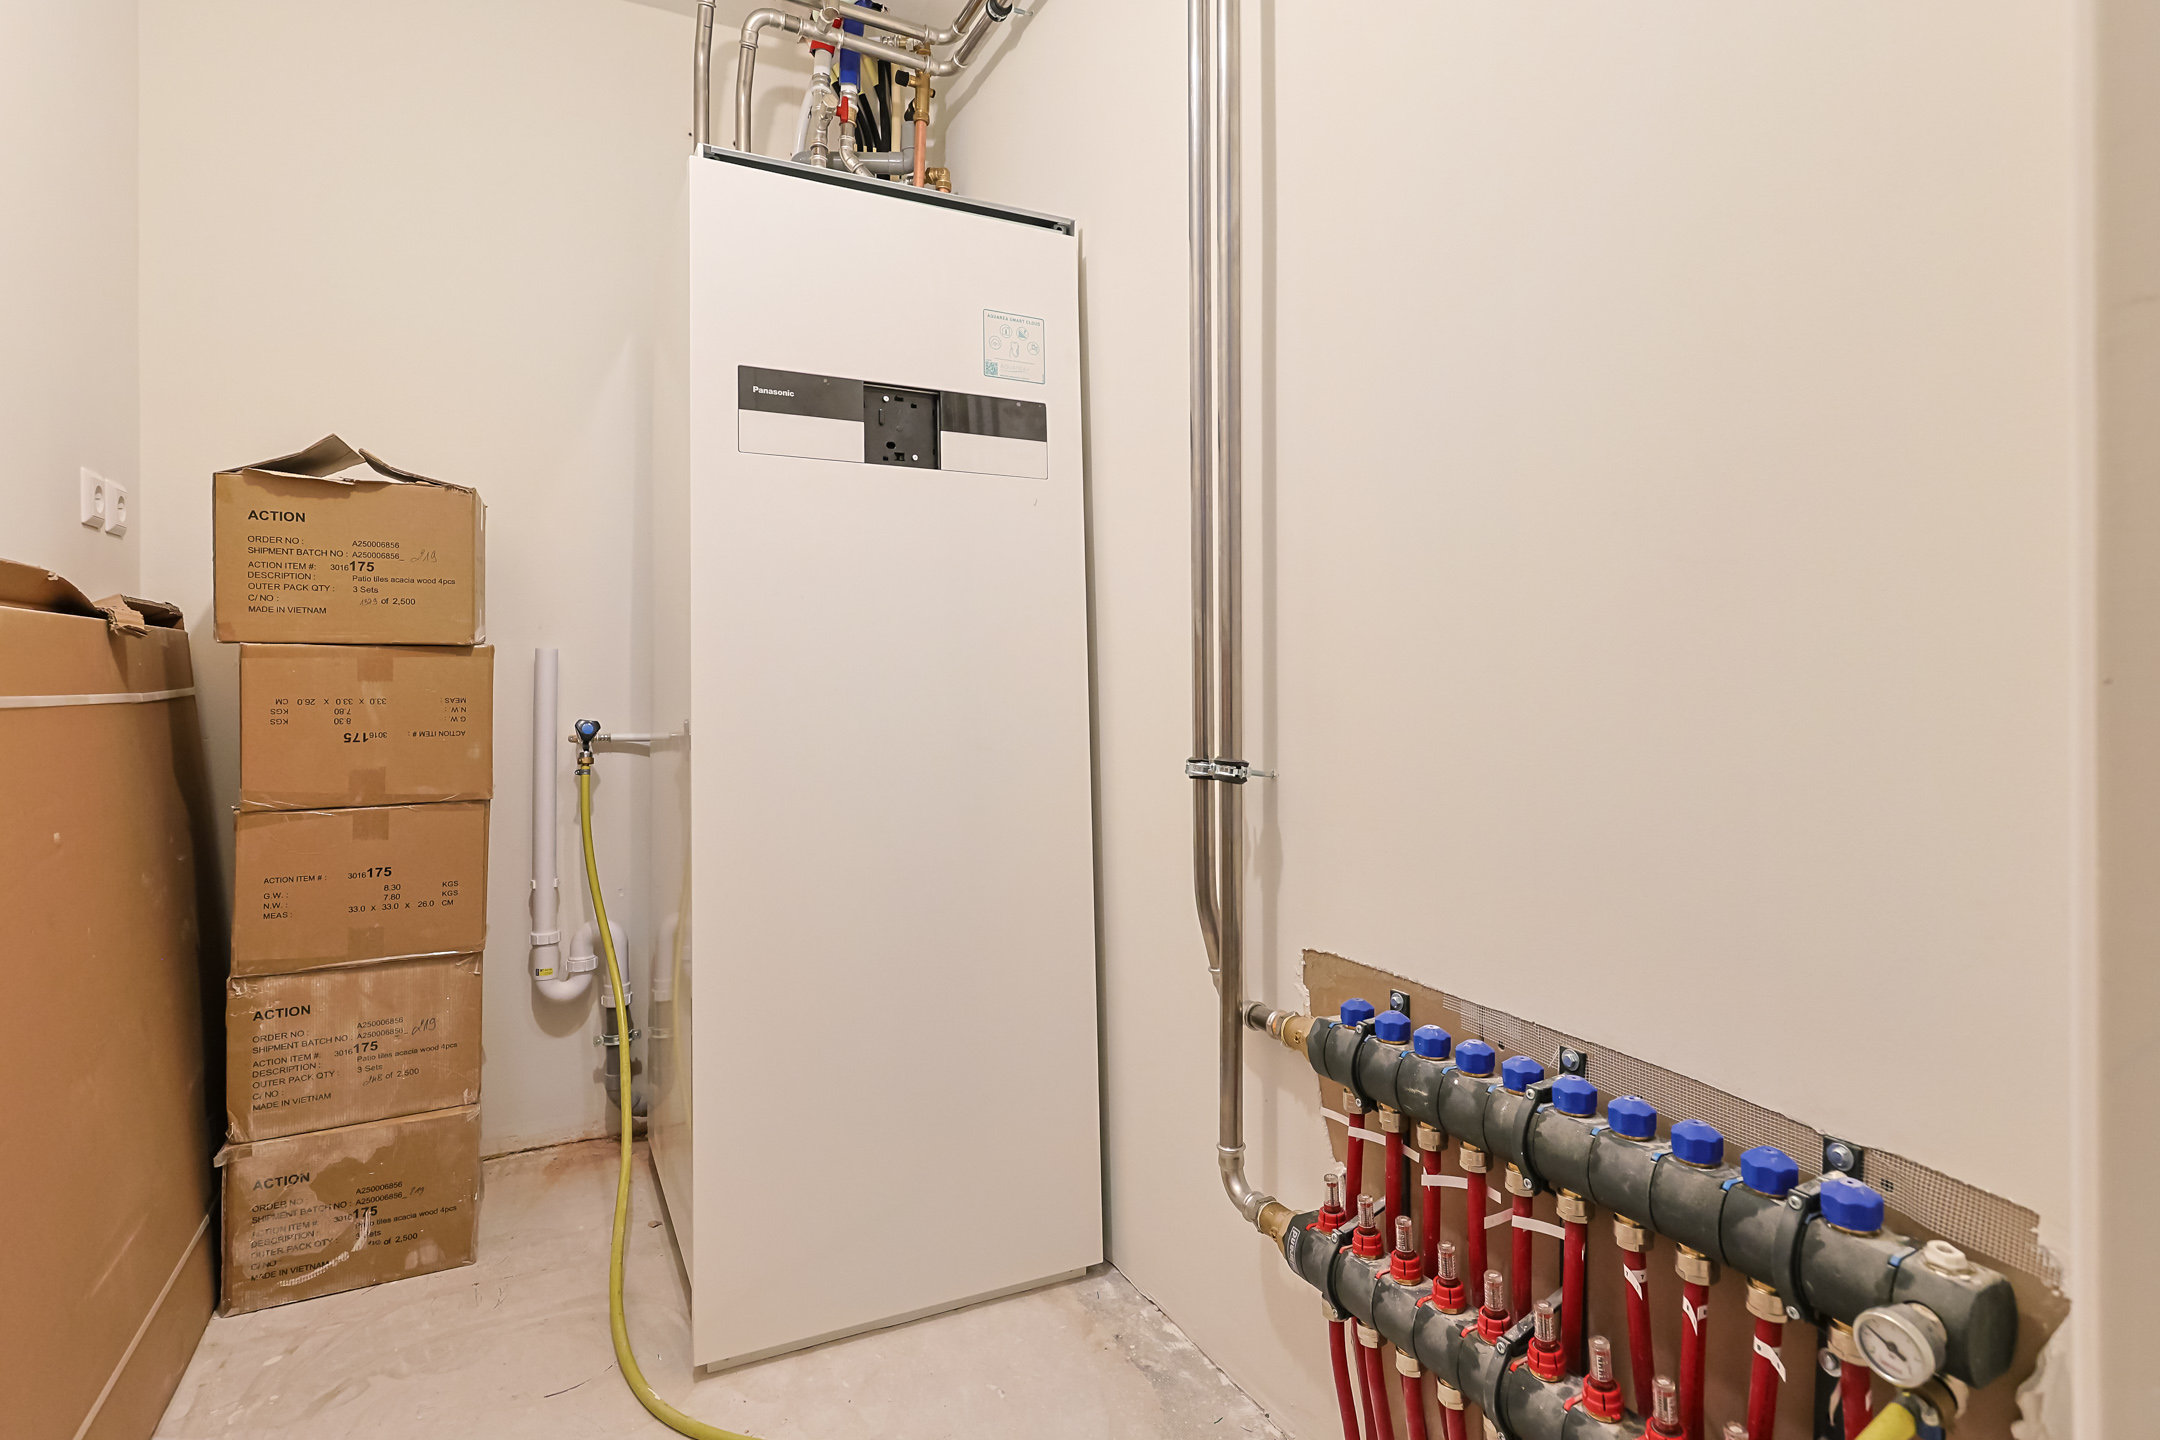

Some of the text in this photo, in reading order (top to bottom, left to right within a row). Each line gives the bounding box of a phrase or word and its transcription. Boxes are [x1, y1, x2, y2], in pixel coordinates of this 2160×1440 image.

[752, 385, 795, 398] Panasonic
[248, 510, 306, 522] ACTION
[248, 535, 282, 544] ORDER
[352, 540, 400, 548] A250006856
[248, 547, 294, 555] SHIPMENT
[248, 561, 282, 569] ACTION
[248, 571, 311, 580] DESCRIPTION
[438, 578, 456, 586] 4pcs
[248, 582, 280, 590] OUTER
[392, 598, 416, 606] 2,500
[264, 876, 294, 884] ACTION
[418, 900, 434, 908] 26.0
[253, 1005, 310, 1021] ACTION
[253, 1032, 287, 1043] ORDER
[291, 1030, 304, 1038] NO
[357, 1017, 403, 1028] A250006856
[253, 1042, 299, 1054] SHIPMENT
[302, 1038, 332, 1047] BATCH
[253, 1063, 316, 1078] DESCRIPTION
[420, 1044, 439, 1053] wood
[441, 1042, 458, 1050] 4pcs
[253, 1057, 287, 1068] ACTION
[290, 1054, 311, 1062] ITEM
[253, 1078, 286, 1089] OUTER
[288, 1074, 313, 1083] PACK
[316, 1071, 335, 1079] QTY
[364, 1064, 383, 1072] Sets
[253, 1101, 279, 1111] MADE
[292, 1093, 331, 1104] VIETNAM
[253, 1172, 310, 1190] ACTION
[252, 1181, 402, 1212] ORDER NO A250006856
[333, 1201, 347, 1209] NO
[251, 1231, 315, 1248] DESCRIPTION
[376, 1216, 391, 1225] tiles
[394, 1213, 416, 1221] acacia
[419, 1209, 438, 1217] wood
[440, 1205, 457, 1214] 4pcs
[289, 1222, 310, 1231] ITEM
[395, 1233, 418, 1243] 2,500
[286, 1242, 312, 1253] PACK
[314, 1238, 334, 1247] QTY
[251, 1261, 329, 1281] MADE IN VIETNAM
